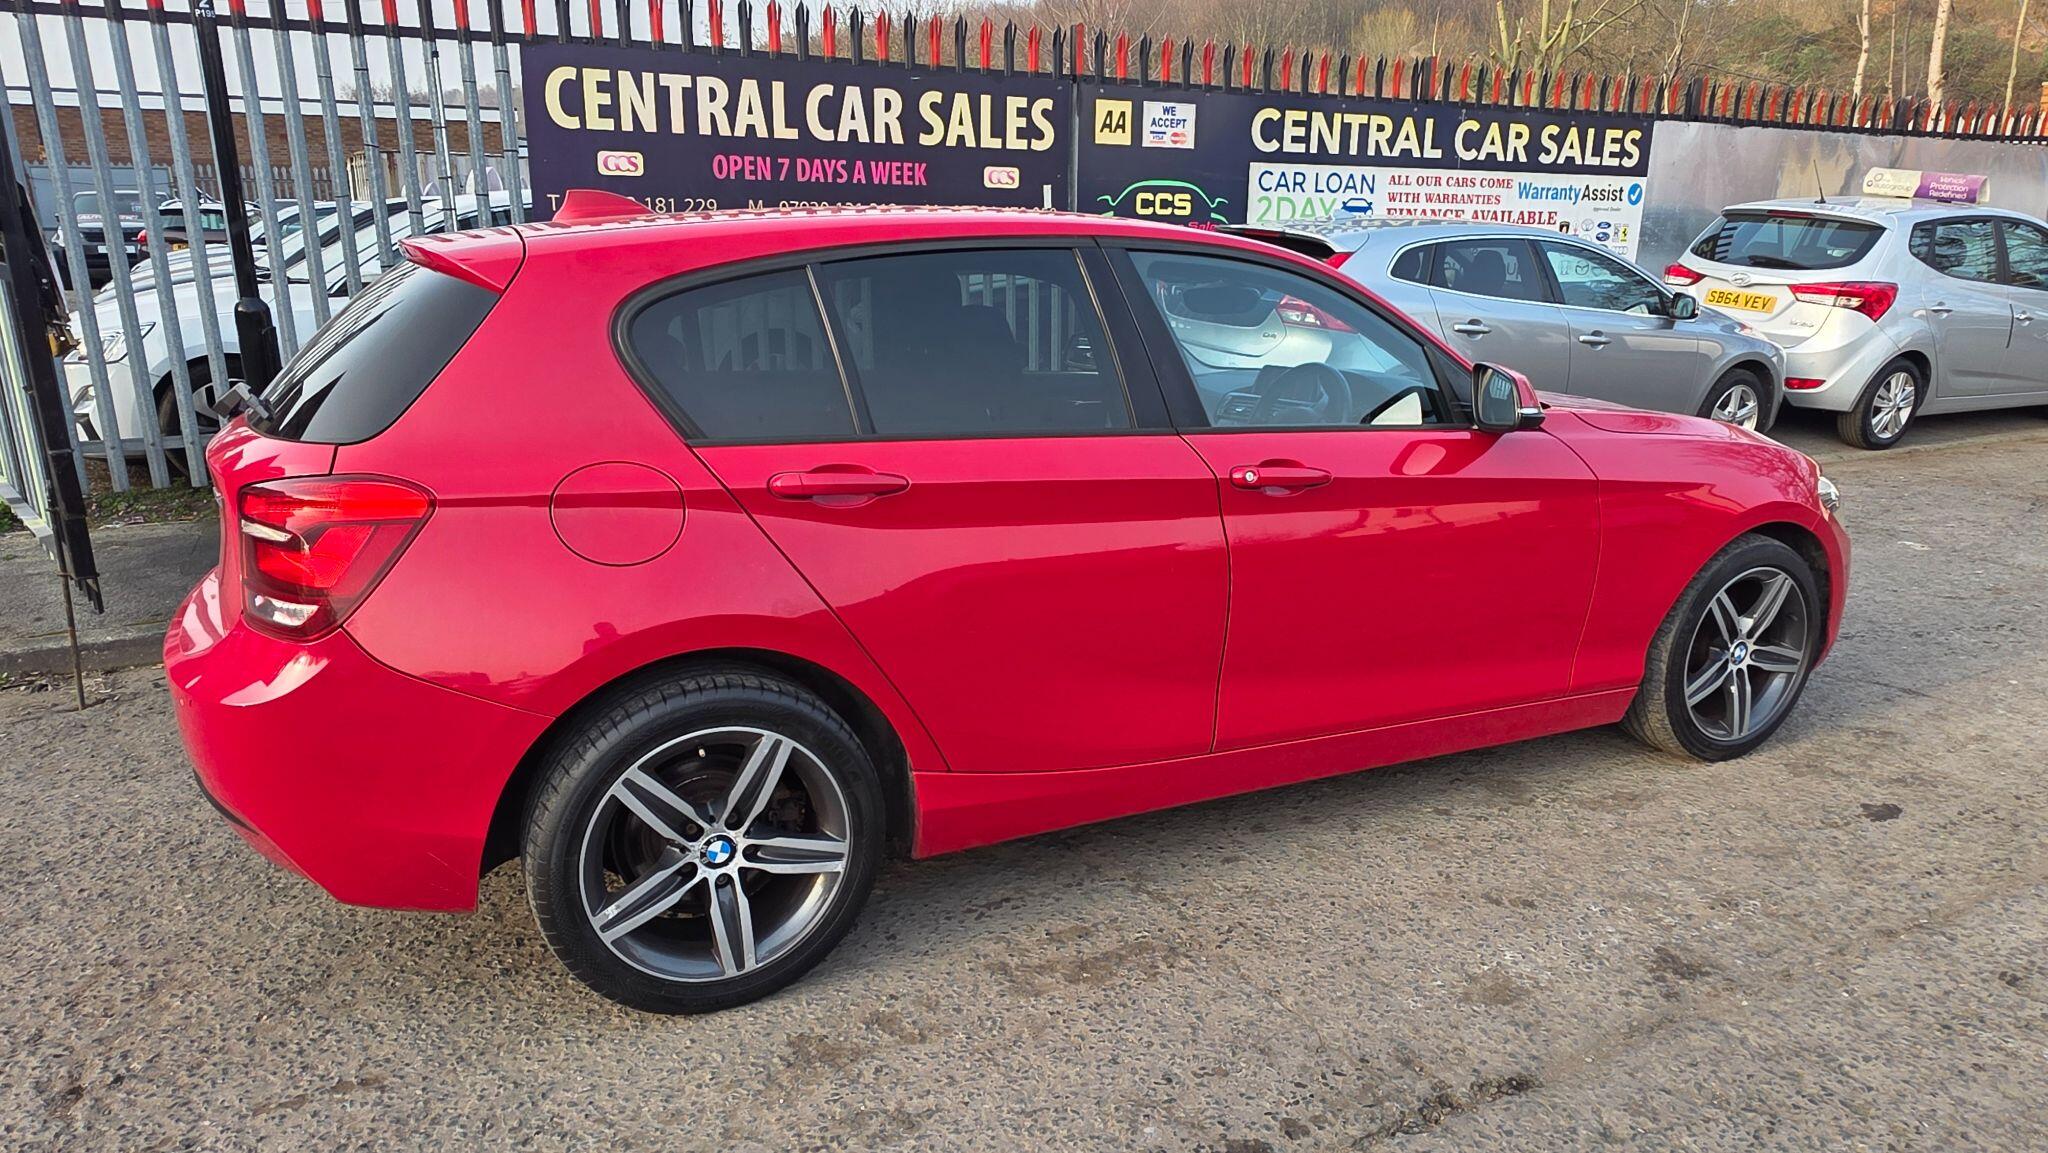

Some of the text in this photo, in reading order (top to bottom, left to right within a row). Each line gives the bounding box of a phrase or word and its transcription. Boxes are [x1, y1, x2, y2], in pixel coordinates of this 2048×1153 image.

[544, 66, 1055, 152] CENTRAL CAR SALES
[1162, 105, 1177, 116] WE
[1100, 110, 1126, 134] AA
[1150, 117, 1188, 129] ACCEPT
[1251, 107, 1643, 168] CENTRAL CAR SALES
[603, 155, 639, 172] CCS
[712, 154, 928, 187] OPEN 7 DAYS A WEEK
[988, 169, 1016, 185] CCS
[1258, 170, 1375, 195] CAR LOAN
[1388, 175, 1514, 190] ALL OUR CARS COME
[1929, 189, 1967, 199] Redefined
[1930, 182, 1969, 192] Protection
[684, 198, 718, 213] 229
[1136, 192, 1192, 216] CCS
[1388, 192, 1502, 206] WITH WARRANTIES
[1257, 196, 1337, 222] 2DAY
[1471, 209, 1557, 225] AVAILABLE
[1708, 291, 1741, 310] SB64
